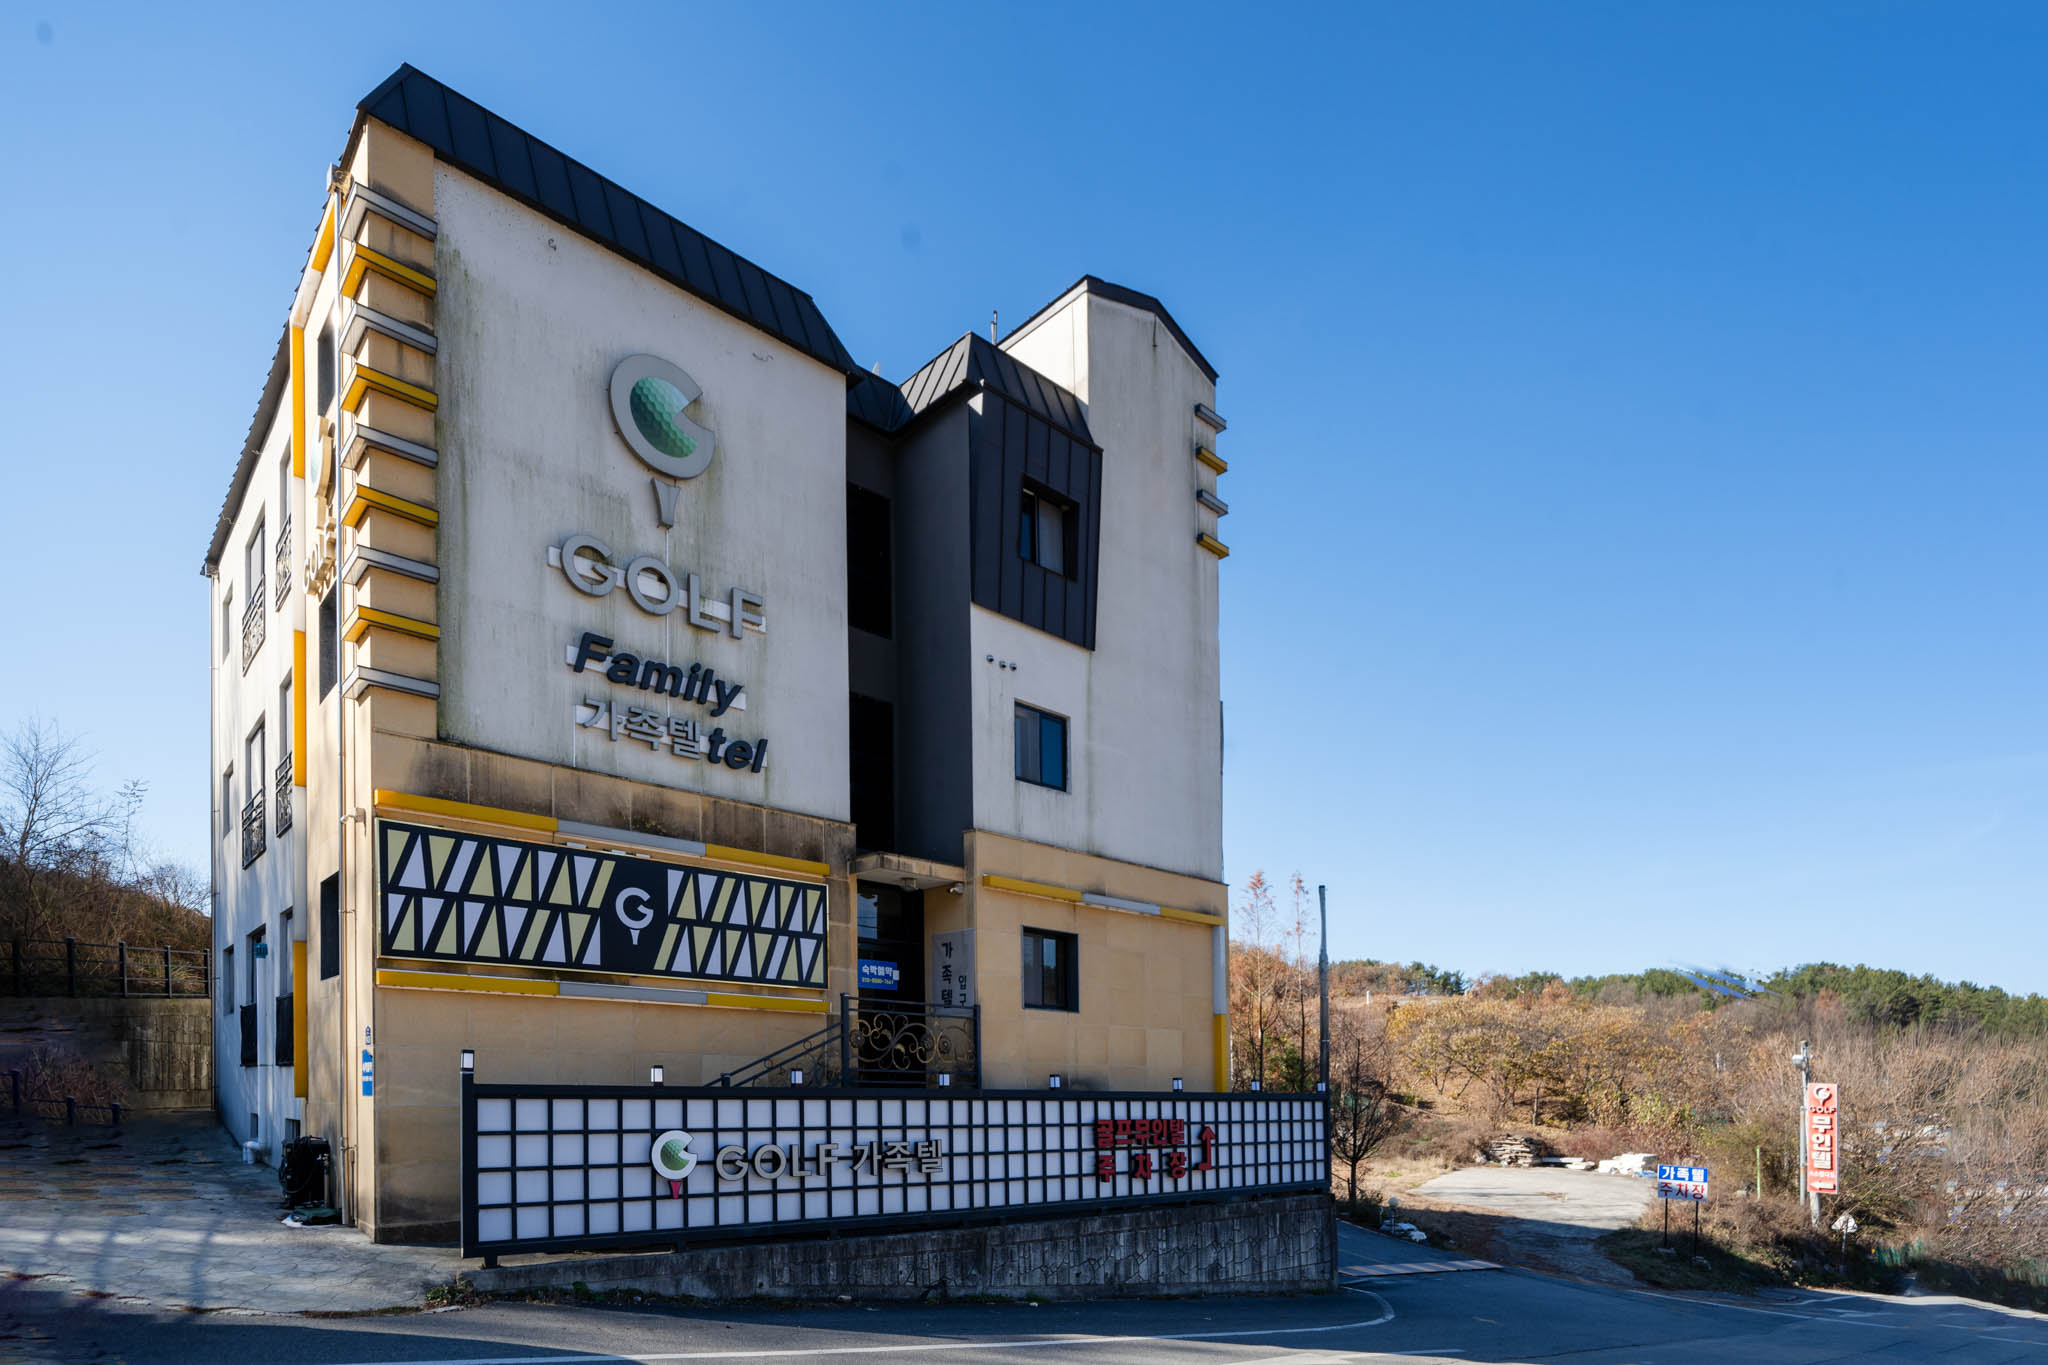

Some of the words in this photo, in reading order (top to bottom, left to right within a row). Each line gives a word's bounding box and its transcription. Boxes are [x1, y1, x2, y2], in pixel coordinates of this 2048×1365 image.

[560, 533, 764, 640] GOLF
[573, 631, 743, 717] Family
[582, 697, 702, 760] 가족텔
[706, 726, 769, 774] tel
[940, 941, 953, 1008] 가족텔
[1809, 1105, 1837, 1114] GOLF
[715, 1143, 839, 1181] GOLF
[849, 1138, 943, 1177] 가족텔
[1660, 1181, 1705, 1200] 주차장
